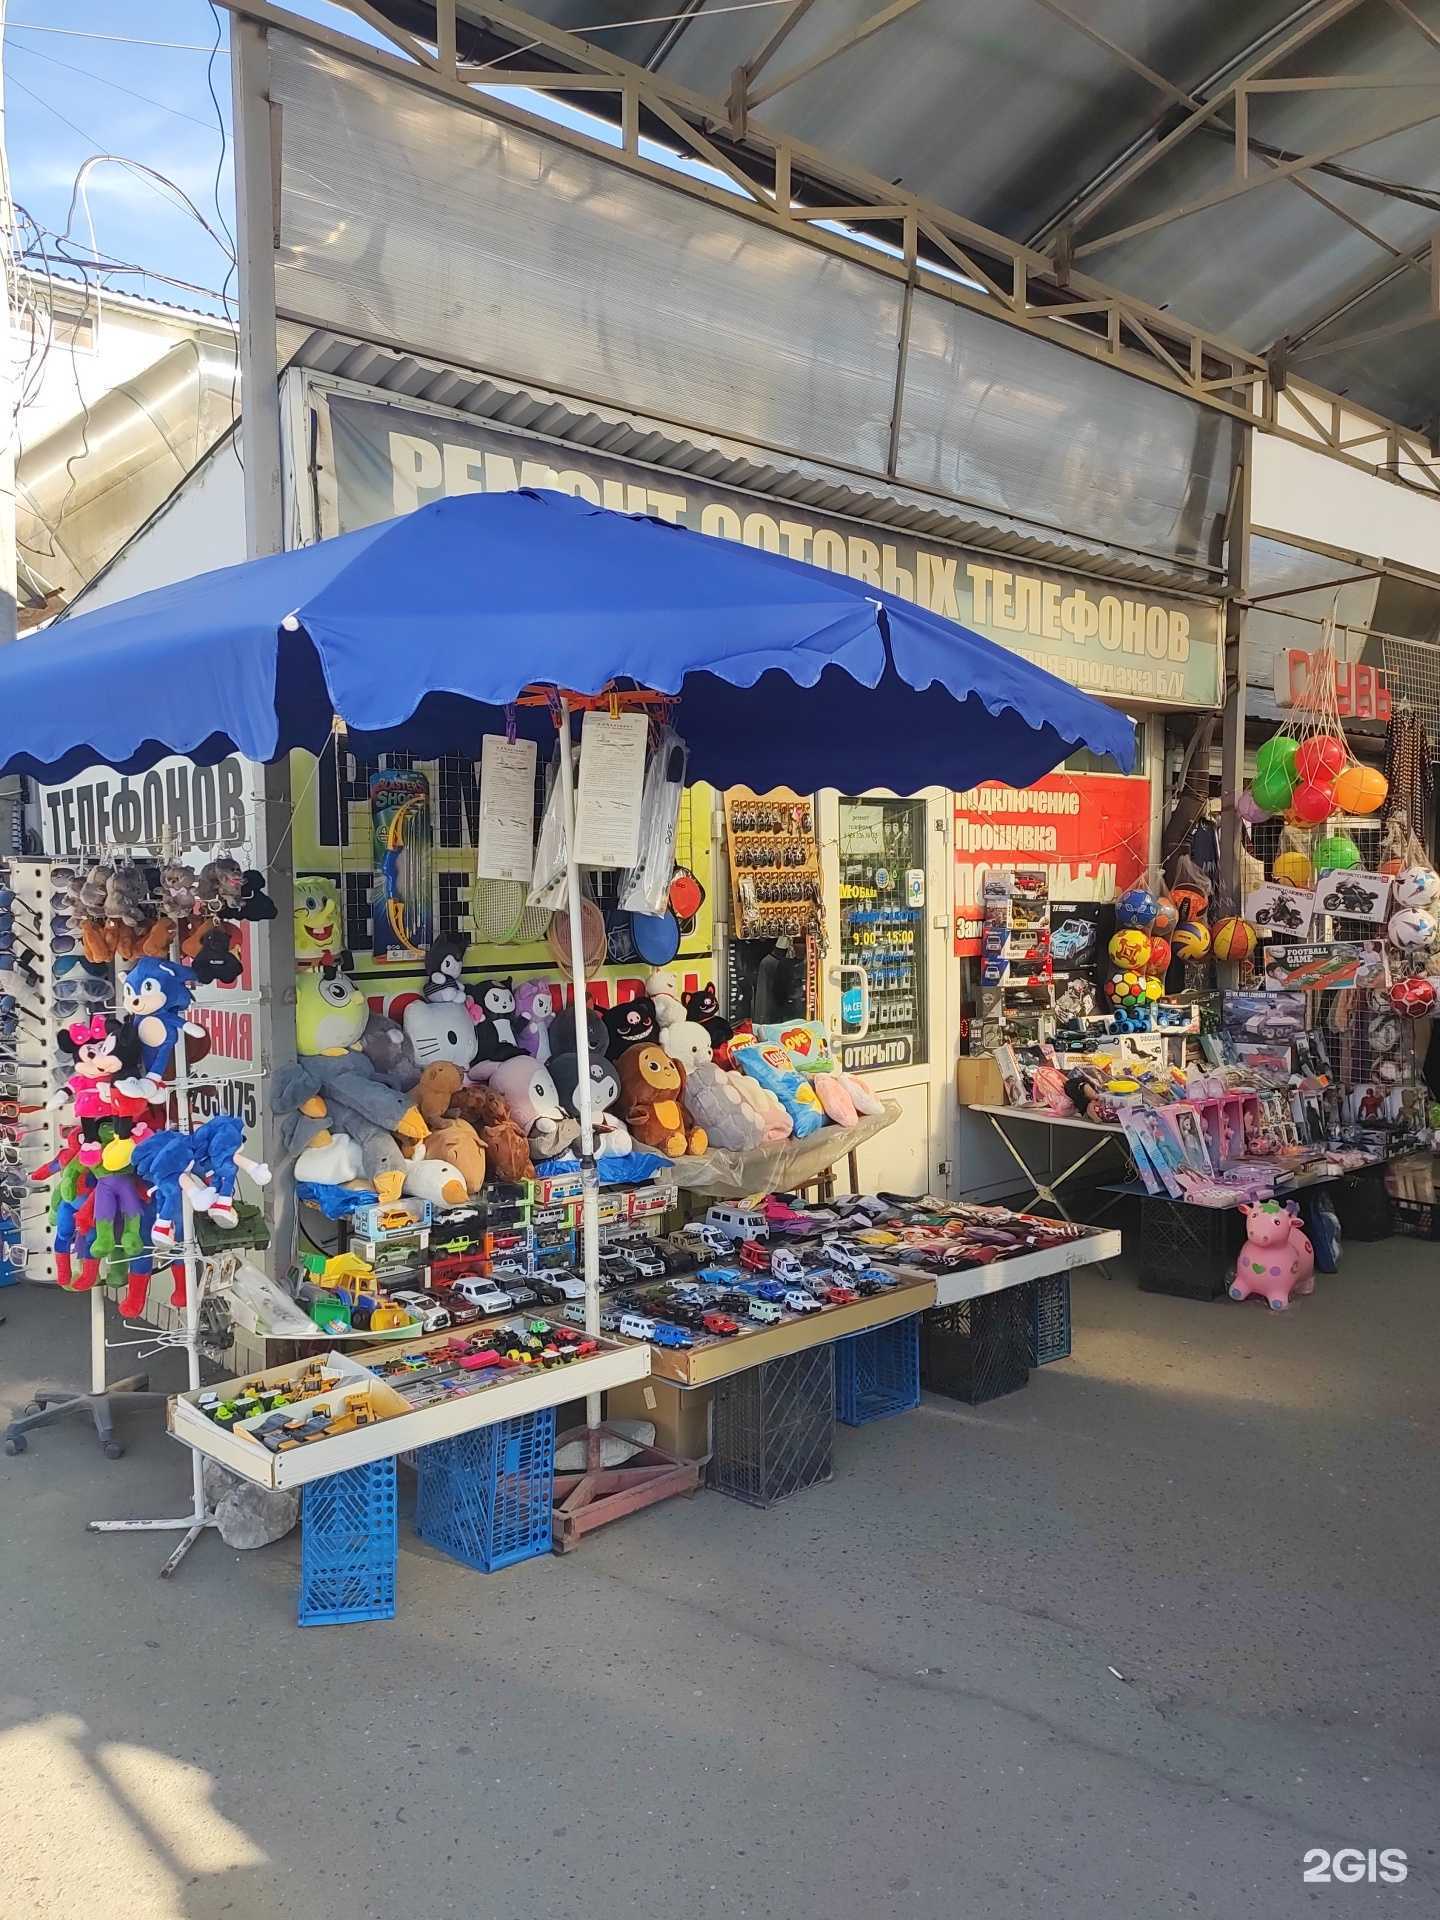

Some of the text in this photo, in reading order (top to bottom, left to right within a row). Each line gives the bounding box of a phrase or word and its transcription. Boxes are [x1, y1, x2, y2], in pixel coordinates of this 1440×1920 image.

[967, 563, 1190, 662] ТЕЛЕФОНОВ
[46, 757, 246, 856] ТЕЛЕФОНОВ
[955, 786, 1080, 816] Подключение
[955, 818, 1057, 853] Прошивка
[1286, 947, 1329, 956] FOOTBALL
[1286, 955, 1314, 963] GAME
[187, 1007, 253, 1062] ЕНИЯ
[844, 1041, 906, 1068] ОТКРЫТО
